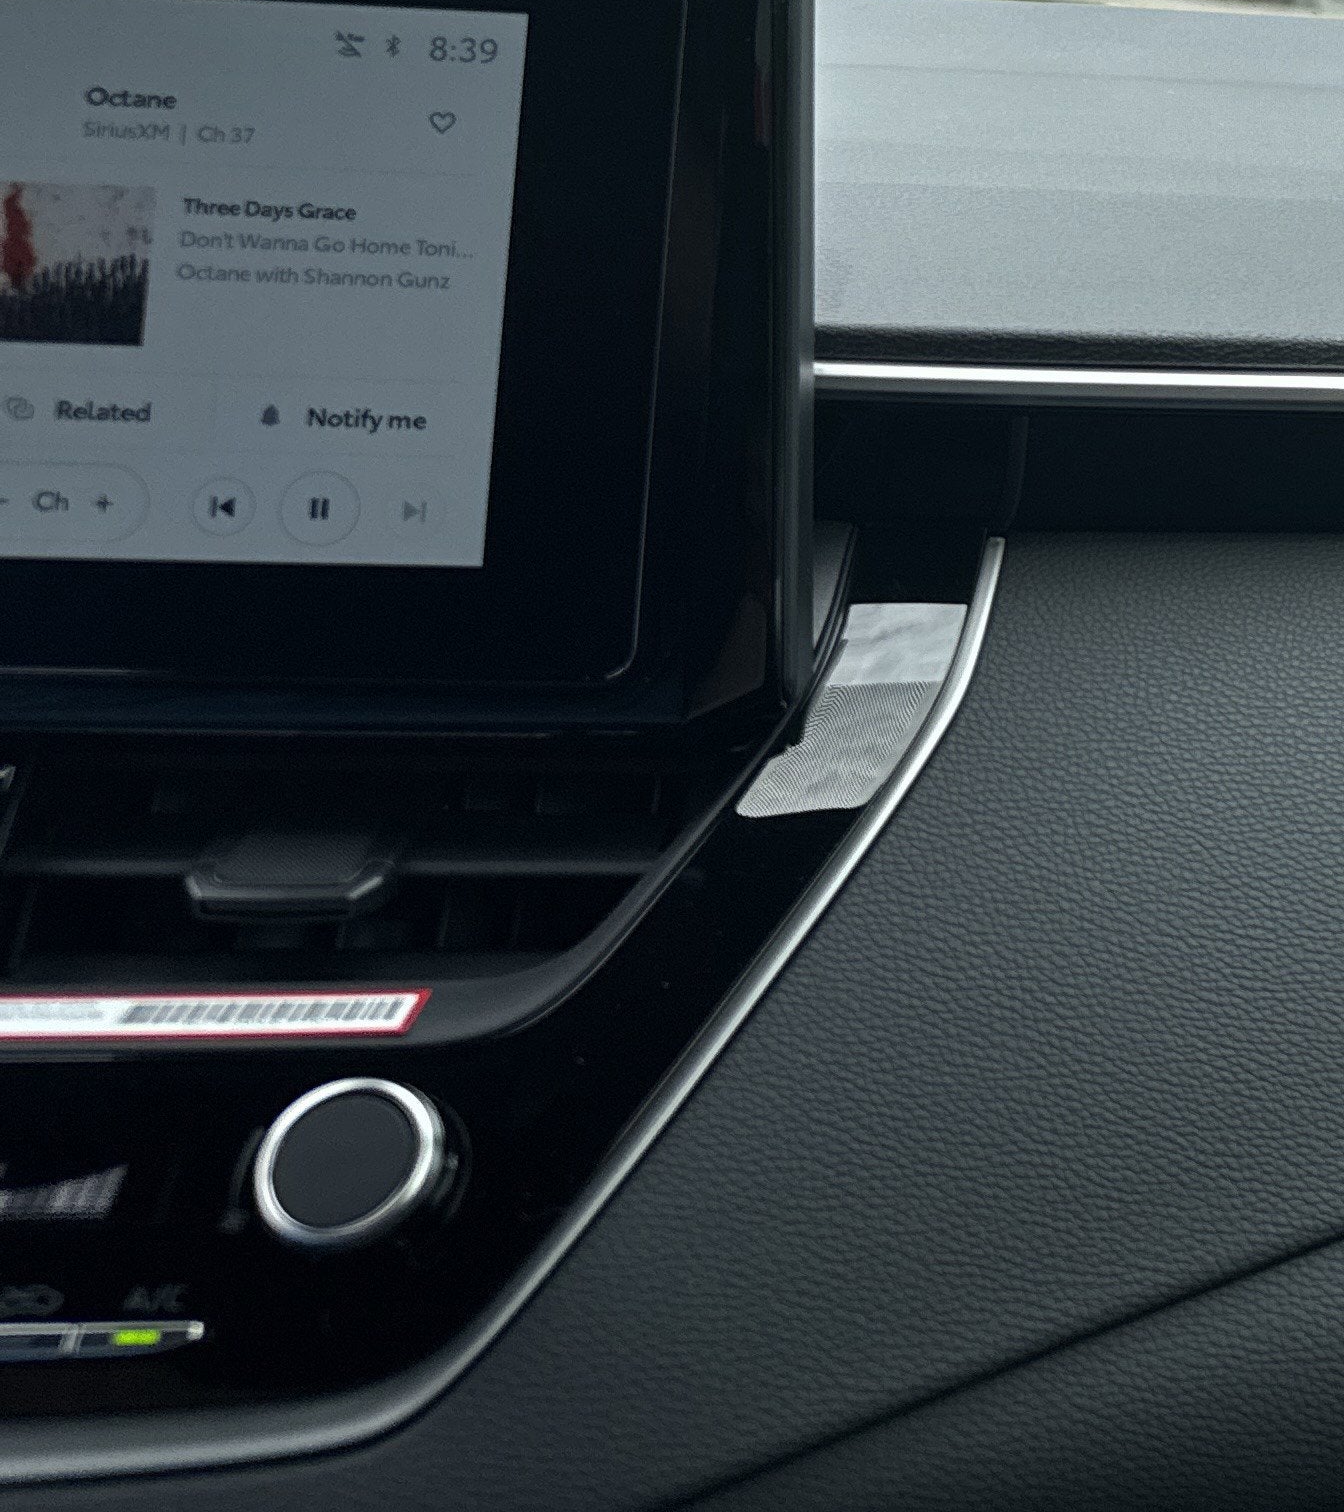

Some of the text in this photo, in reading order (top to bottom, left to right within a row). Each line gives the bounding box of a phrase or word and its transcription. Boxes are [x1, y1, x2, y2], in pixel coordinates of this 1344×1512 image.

[428, 35, 499, 65] 8:39
[85, 86, 178, 110] Octane
[82, 121, 256, 144] SiriusXM Ch 37
[183, 197, 357, 223] Three Days Grace
[178, 230, 235, 250] Don't
[239, 232, 310, 252] Wanna
[314, 236, 346, 254] Go
[351, 237, 411, 257] Home
[175, 263, 451, 290] Octane with Shannon Gunz
[55, 399, 152, 423] Related
[307, 406, 428, 434] Notify me
[32, 490, 69, 513] Ch
